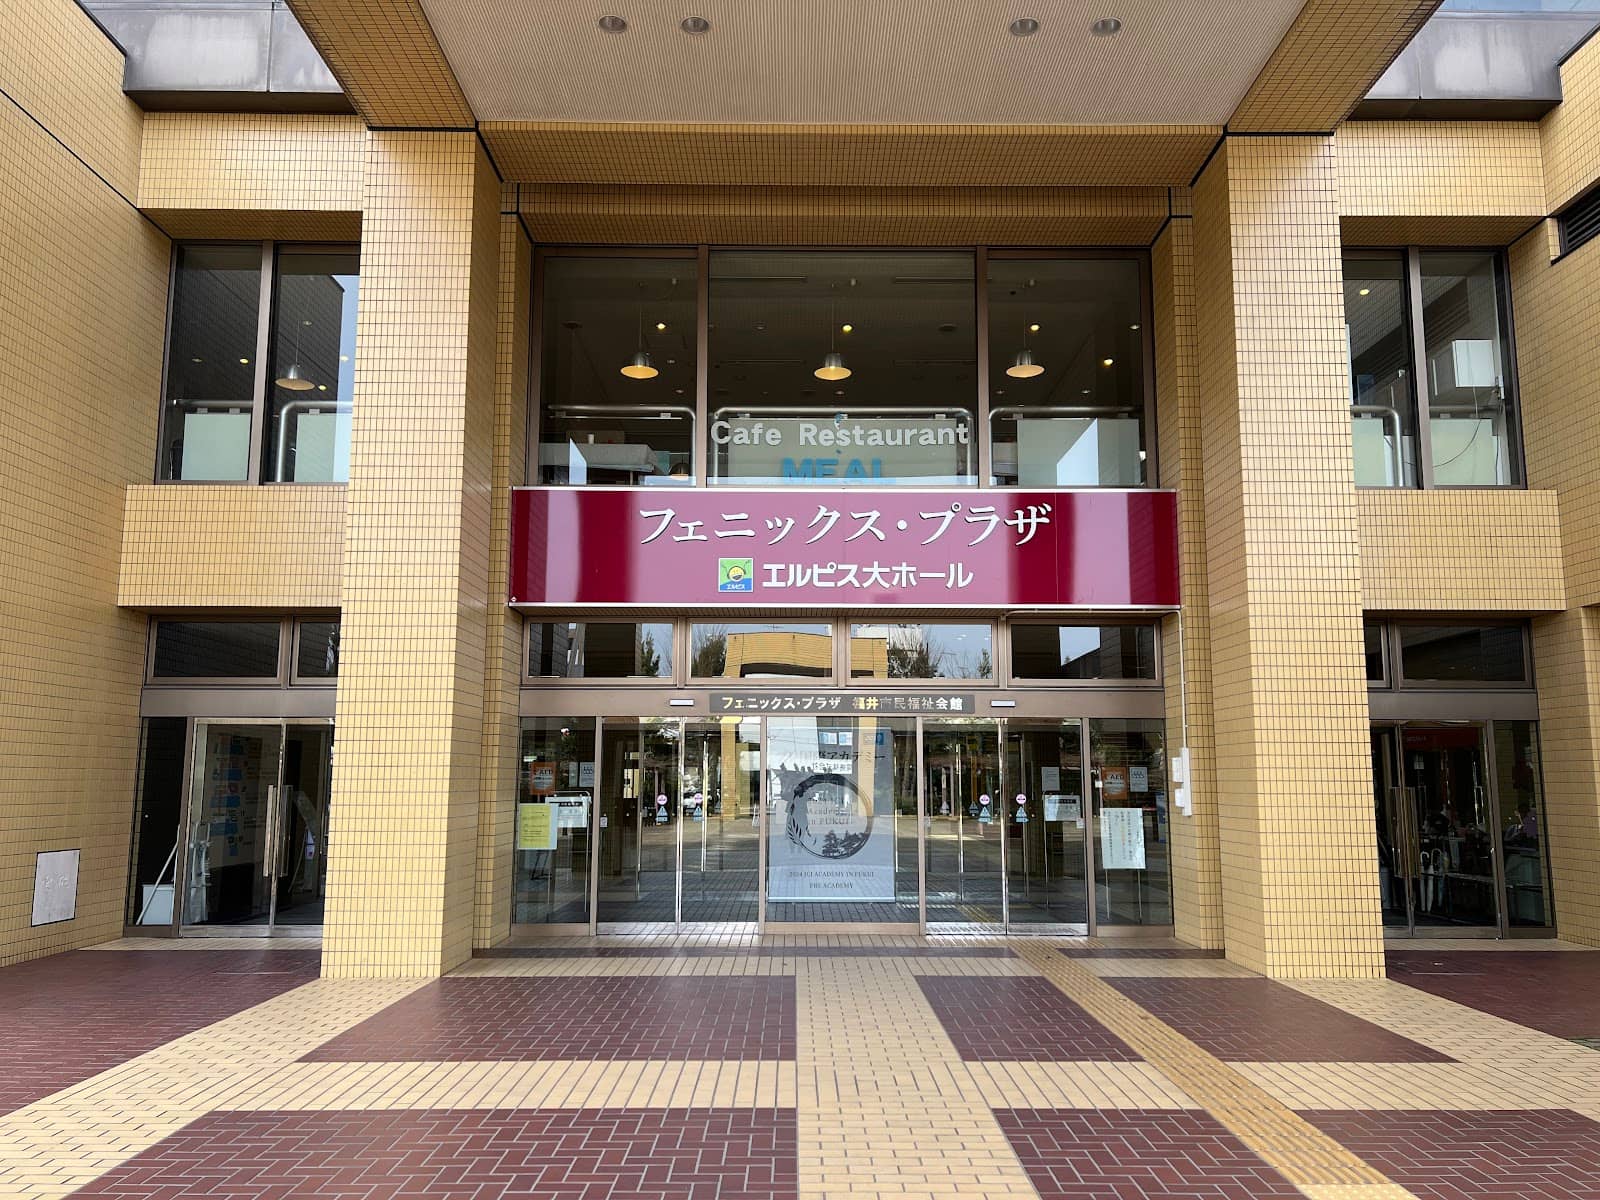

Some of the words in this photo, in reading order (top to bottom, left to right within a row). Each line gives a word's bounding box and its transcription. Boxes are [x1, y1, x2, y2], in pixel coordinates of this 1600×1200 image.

[710, 421, 782, 445] Cafe
[799, 422, 969, 446] Restaurant
[781, 457, 894, 484] MEAL
[639, 502, 1052, 547] フェニックス・プラザ
[762, 560, 973, 589] エルピス大ホール
[722, 696, 842, 710] フェニックス・プラザ
[852, 696, 963, 711] 福井市民福祉会館
